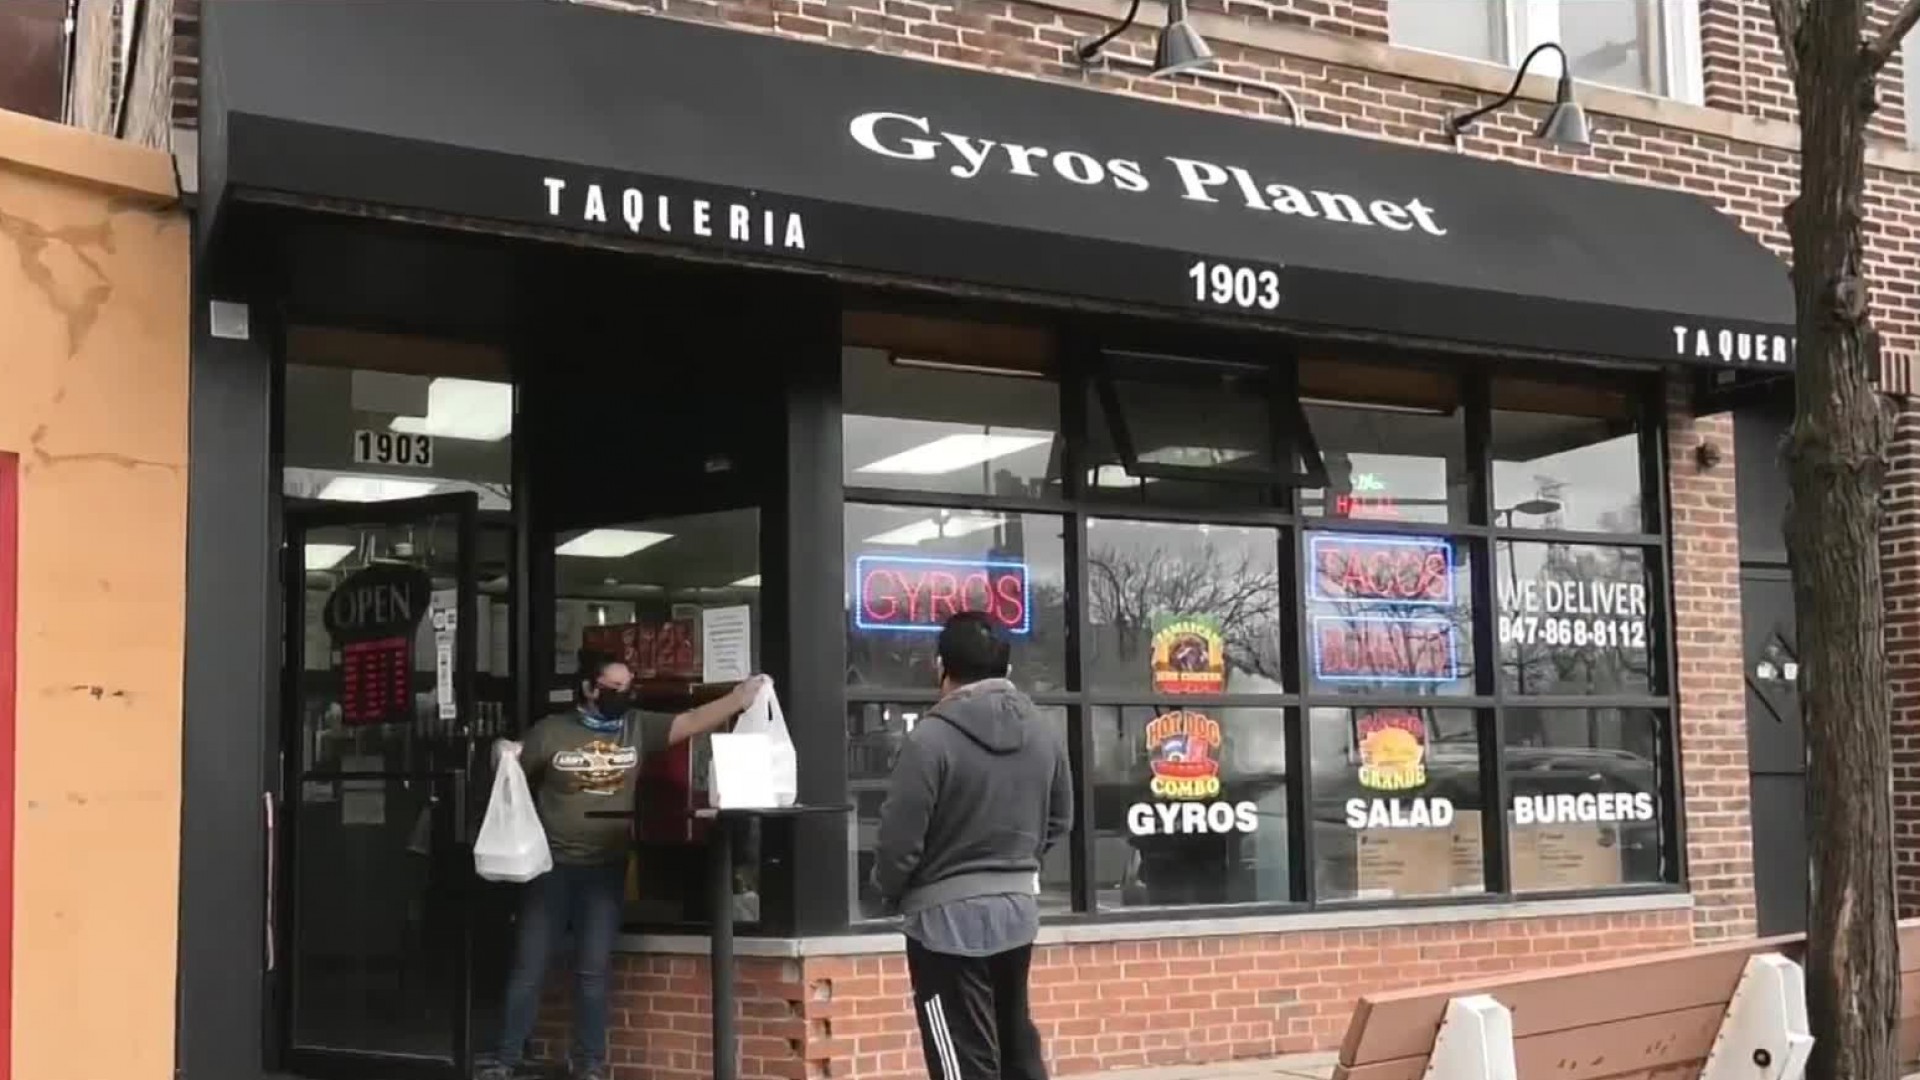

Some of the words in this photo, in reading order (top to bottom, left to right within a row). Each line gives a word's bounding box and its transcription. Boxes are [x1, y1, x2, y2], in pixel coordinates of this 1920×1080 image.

[850, 112, 1149, 192] Gyros
[1165, 156, 1447, 236] Planet
[1189, 261, 1280, 309] 1903
[358, 431, 431, 465] 1903
[1317, 547, 1447, 598] TACOS
[332, 581, 412, 627] OPEN
[863, 569, 1023, 624] GYROS
[1499, 578, 1538, 612] WE
[1546, 581, 1646, 615] DELIVER
[1498, 617, 1646, 648] 847-868-8112
[1150, 776, 1220, 799] COMBO
[1127, 801, 1259, 836] GYROS
[1345, 797, 1455, 829] SALAD
[1513, 792, 1653, 825] BURGERS
